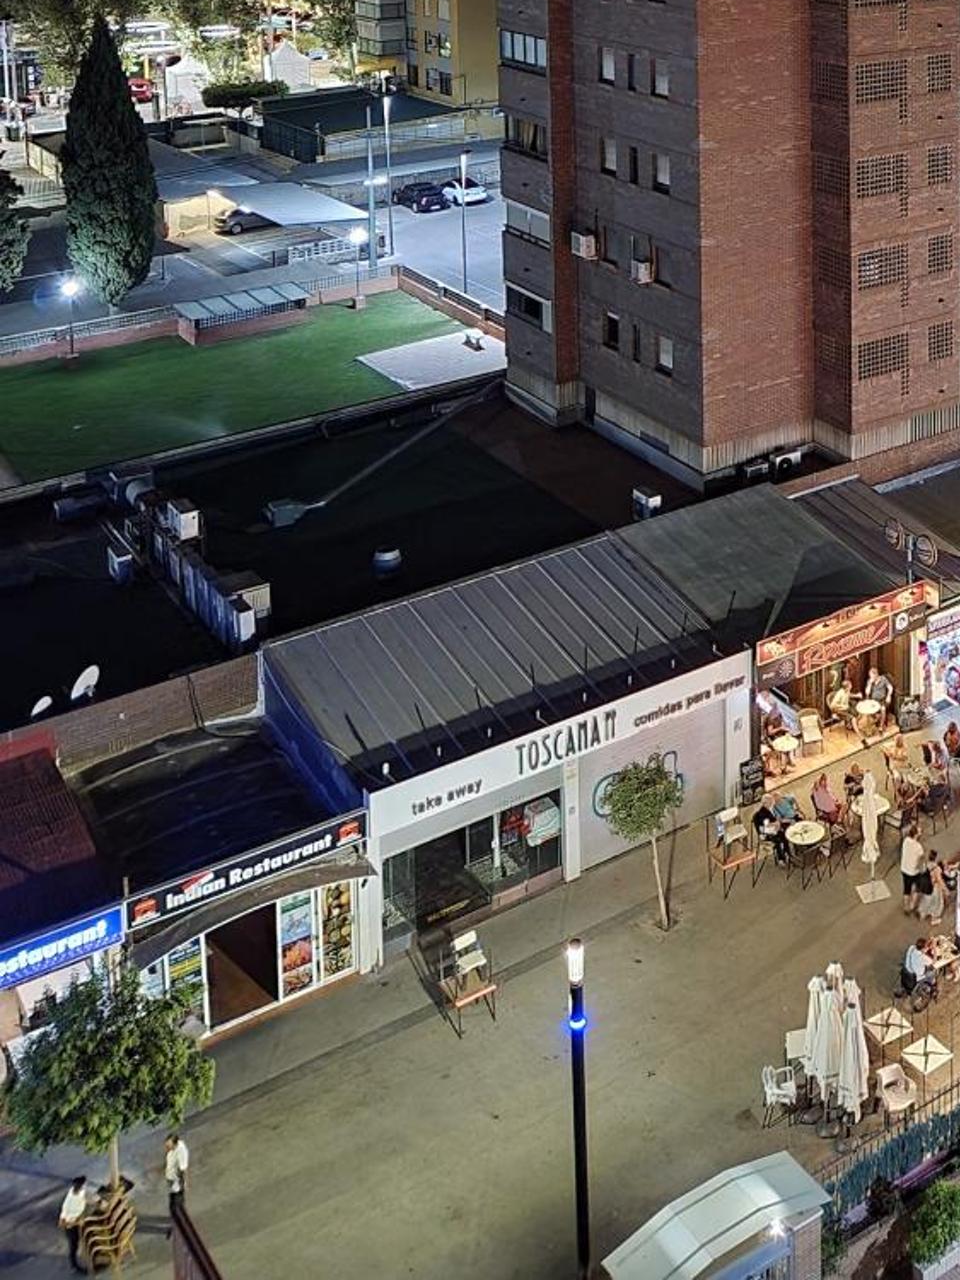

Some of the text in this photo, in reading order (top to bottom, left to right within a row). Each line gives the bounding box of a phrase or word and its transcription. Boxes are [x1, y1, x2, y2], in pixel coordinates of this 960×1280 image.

[633, 700, 684, 727] comidas
[685, 689, 712, 710] para
[515, 715, 601, 775] TOSCANA
[411, 778, 483, 816] take away
[165, 833, 333, 910] Indian Restaurant
